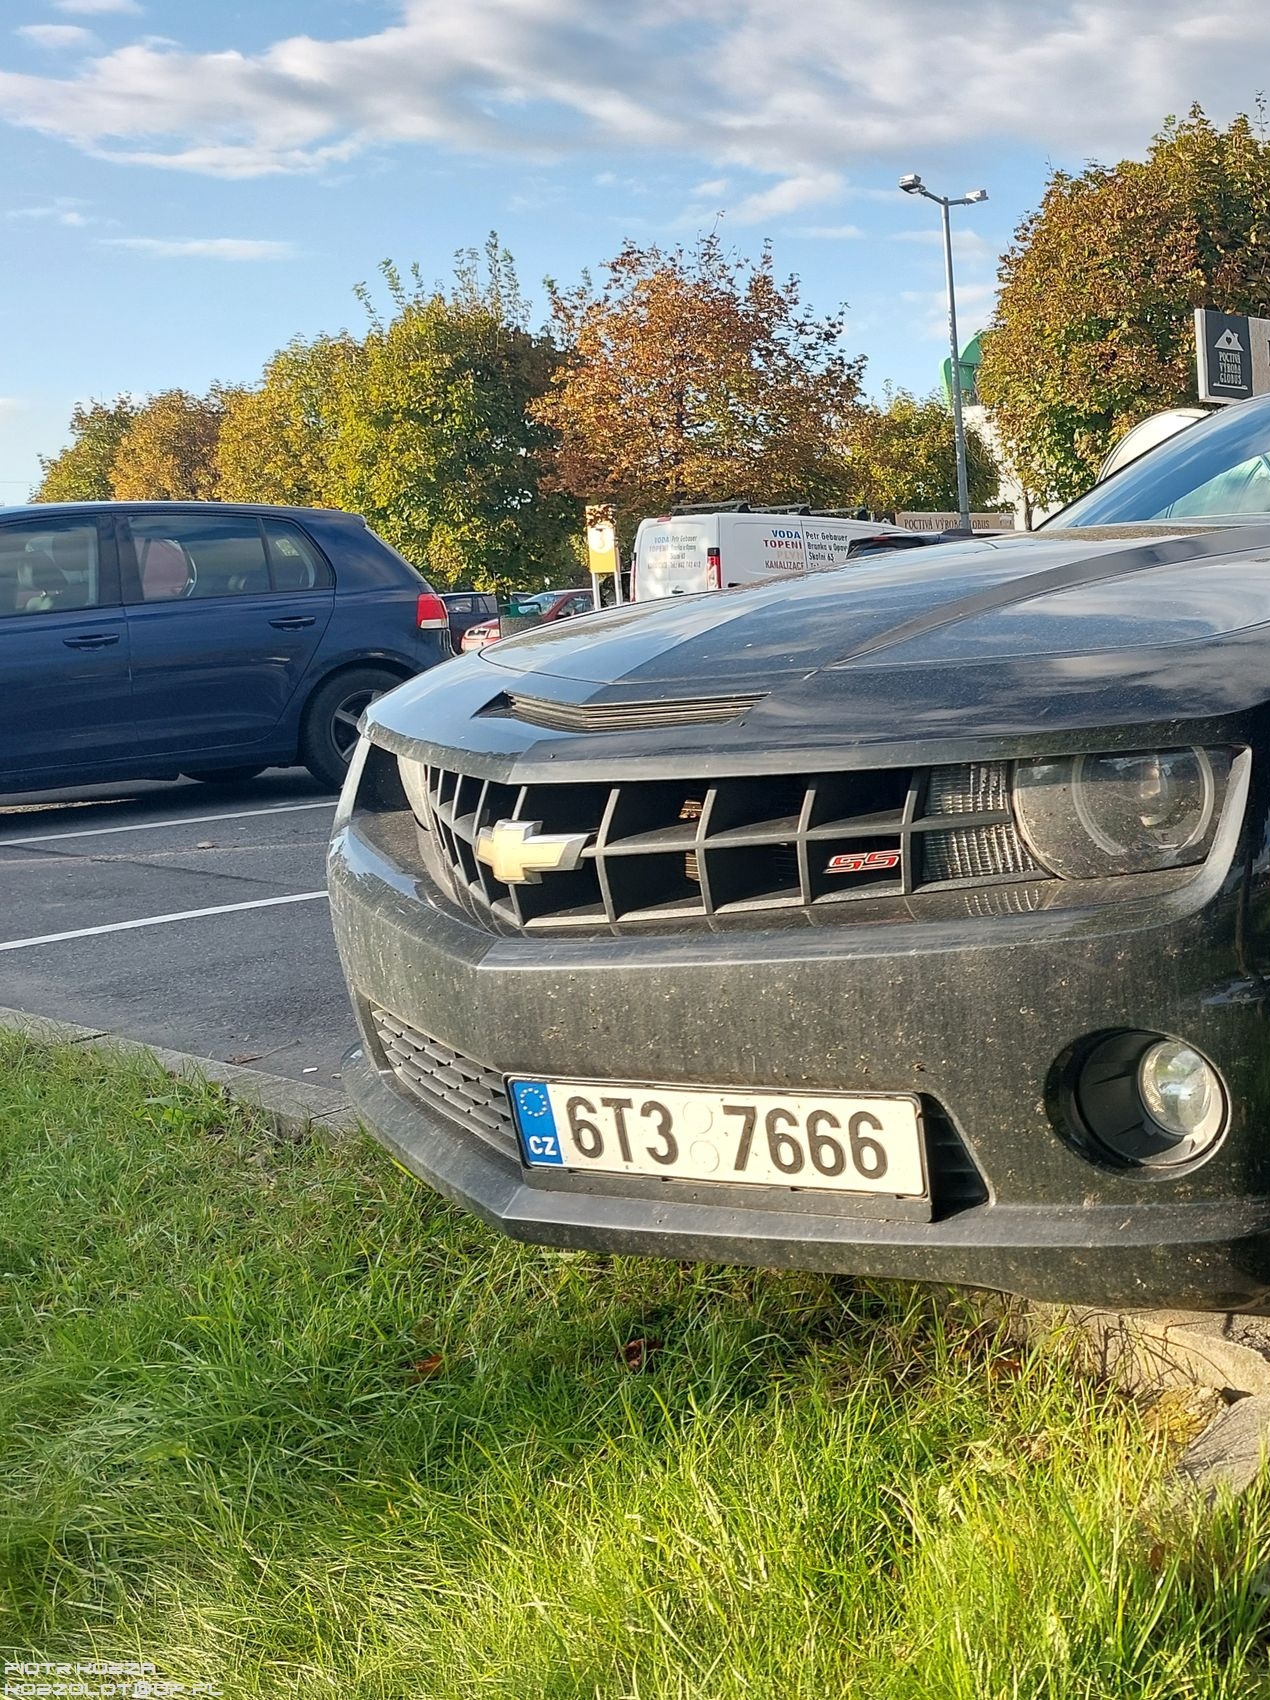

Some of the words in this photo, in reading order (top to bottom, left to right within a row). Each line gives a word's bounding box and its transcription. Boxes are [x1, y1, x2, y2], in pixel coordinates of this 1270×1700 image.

[771, 529, 802, 539] VODA
[805, 531, 819, 540] Petr
[821, 532, 848, 541] Gebauer
[823, 848, 902, 874] SS
[528, 1134, 558, 1156] CZ
[565, 1095, 680, 1166] 6T3
[722, 1105, 889, 1180] 7666
